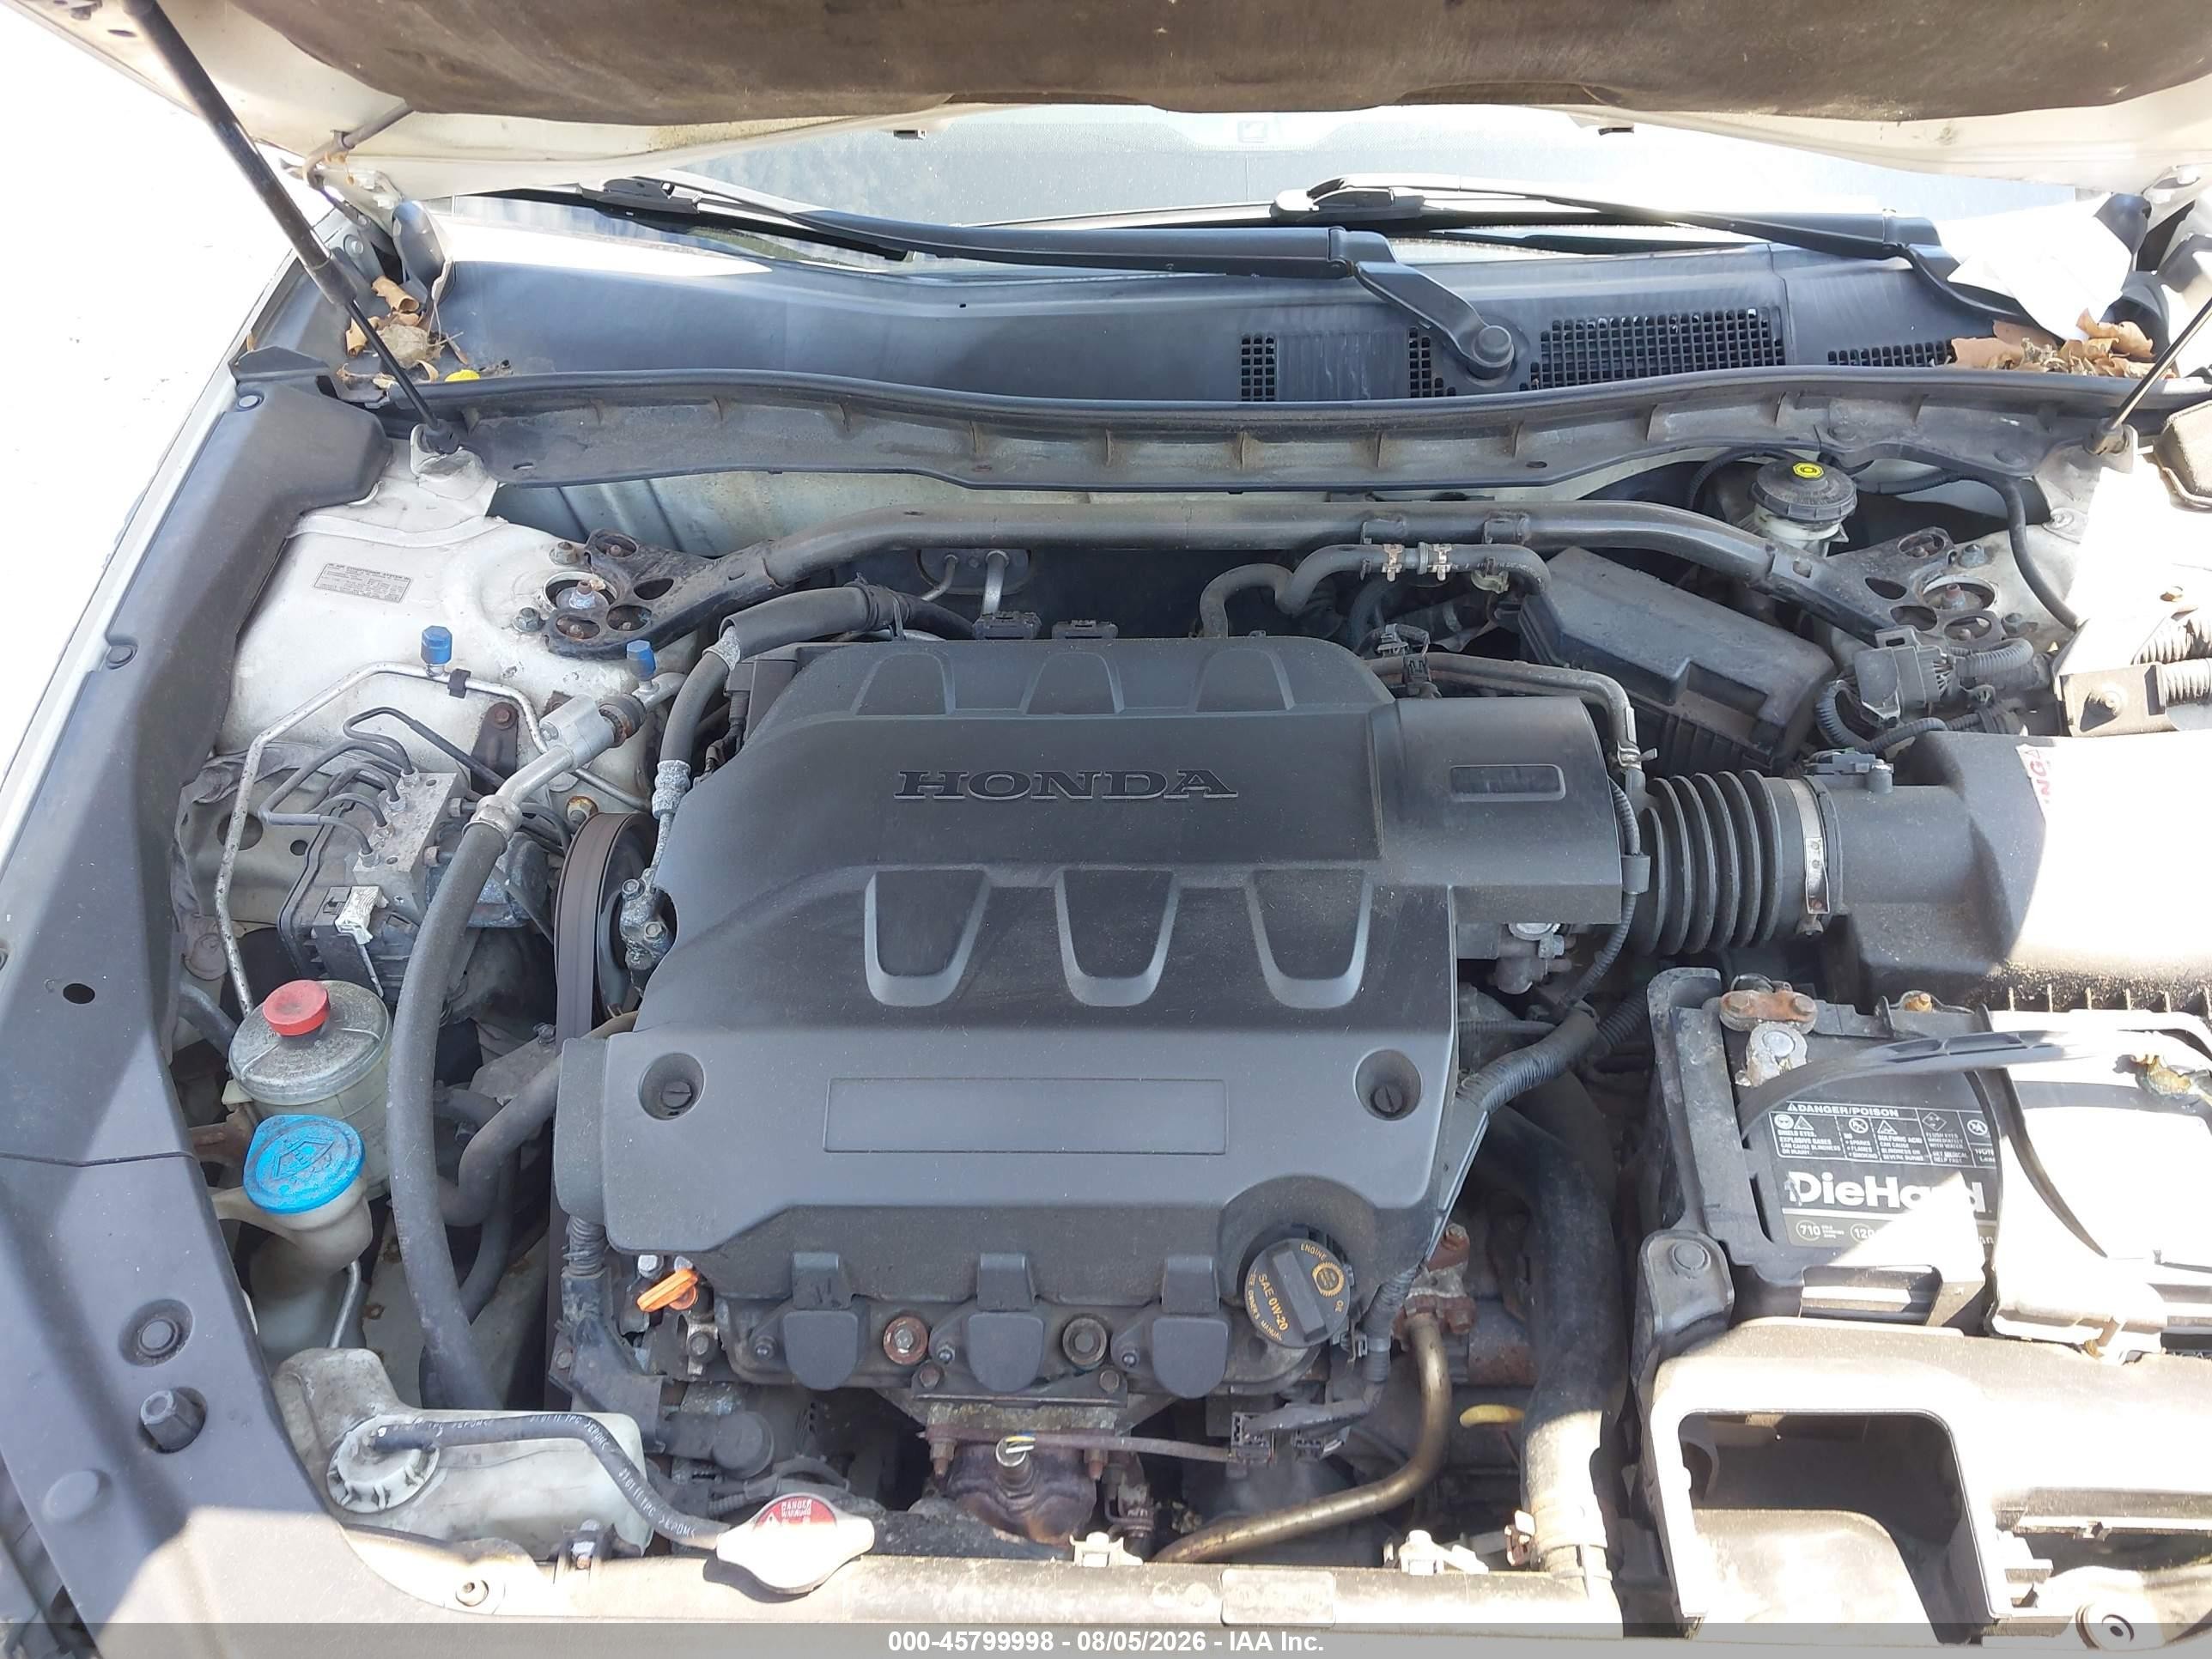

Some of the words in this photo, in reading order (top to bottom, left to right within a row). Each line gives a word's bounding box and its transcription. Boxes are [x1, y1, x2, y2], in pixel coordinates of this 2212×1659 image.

[893, 769, 1238, 800] HONDA
[1798, 1104, 1899, 1117] DANGER/POISON
[1779, 1136, 1812, 1145] EXPLOSIVE
[1877, 1134, 1907, 1143] SULFURIC
[1787, 1171, 1986, 1213] DieHad
[1800, 1224, 1821, 1236] 710
[1301, 1243, 1328, 1261] ENGINE
[1259, 1273, 1274, 1297] SAE
[1268, 1297, 1289, 1331] 0W-20
[1261, 1320, 1283, 1340] MANUAL
